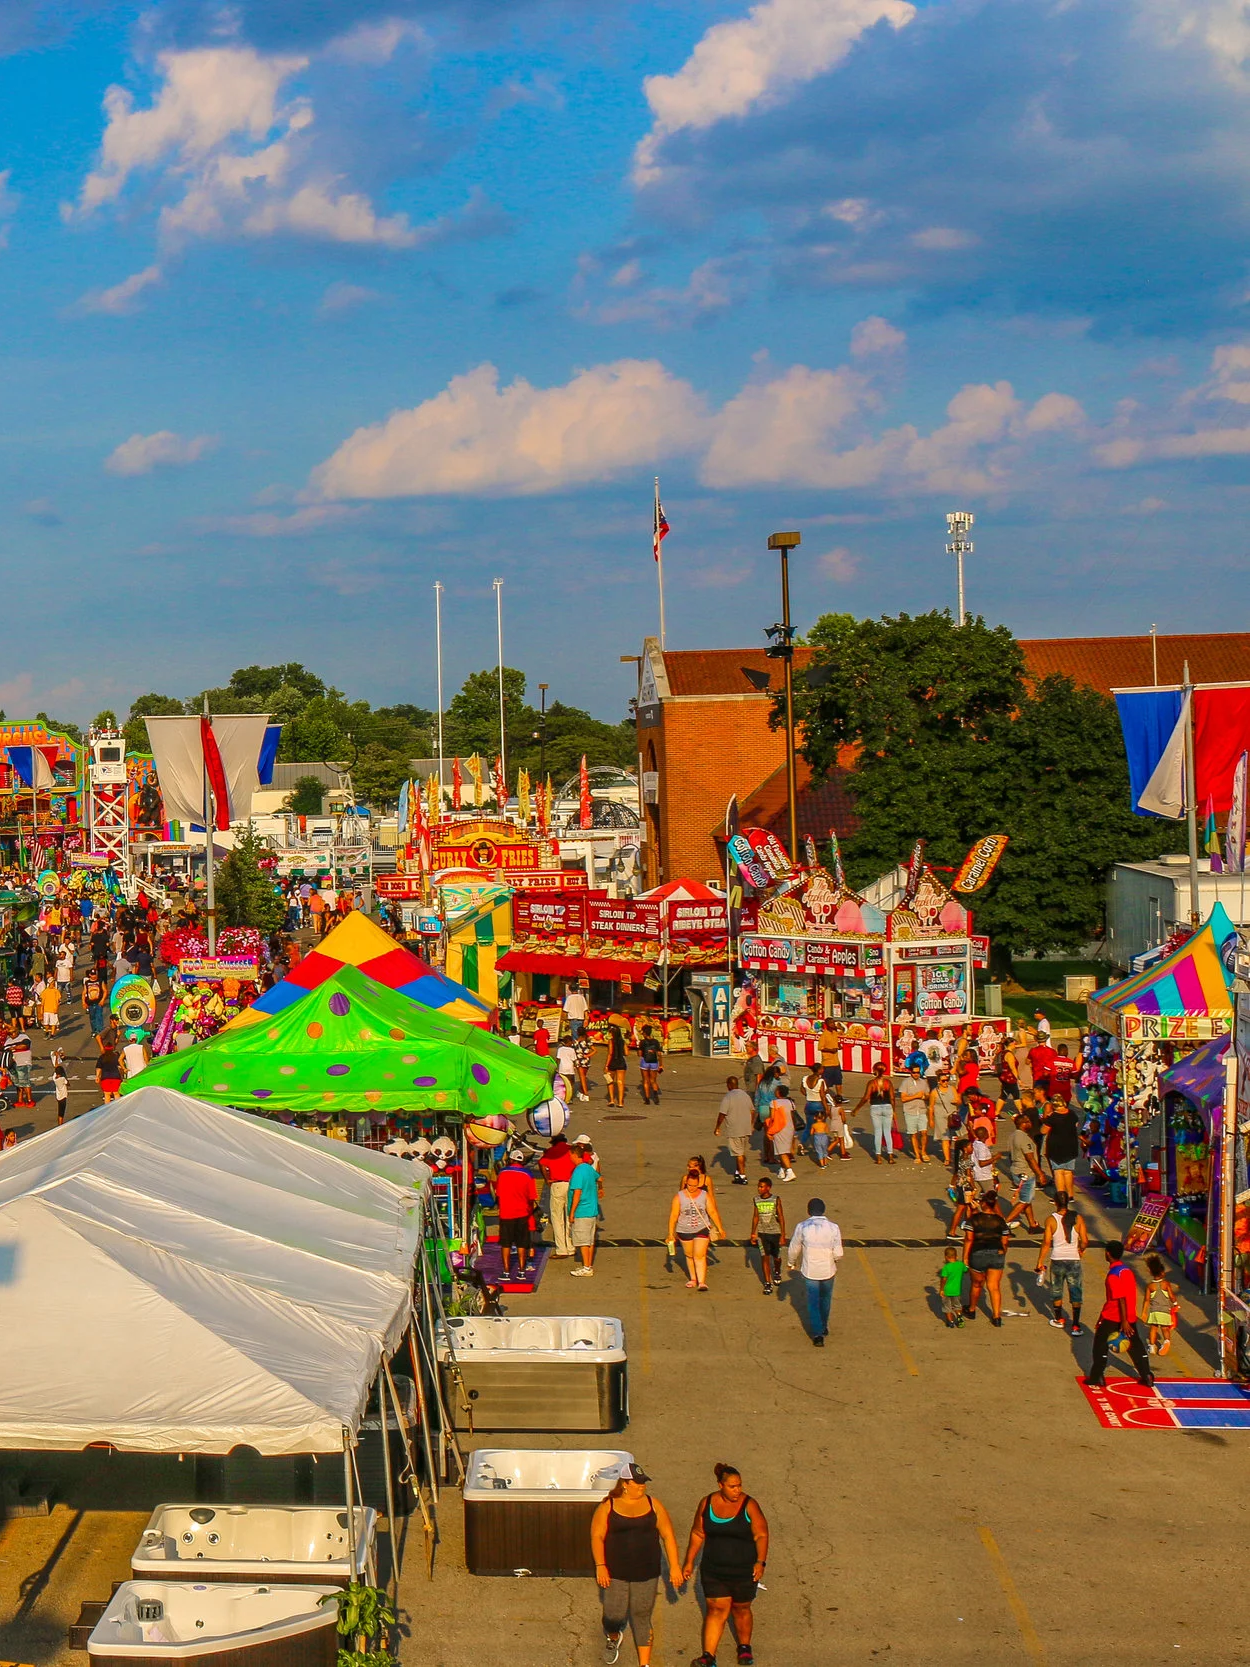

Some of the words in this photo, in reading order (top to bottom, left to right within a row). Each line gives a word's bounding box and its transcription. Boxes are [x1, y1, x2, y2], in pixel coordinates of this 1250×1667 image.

[766, 835, 775, 846] Old
[432, 851, 467, 871] CURLY
[501, 850, 534, 867] FRIES
[734, 837, 754, 866] Cotton
[749, 862, 768, 888] Candy
[961, 855, 987, 890] Caramel
[978, 837, 998, 858] Corn
[390, 880, 406, 891] DOGS
[506, 878, 524, 887] RLY
[527, 877, 557, 886] FRIES
[530, 903, 554, 915] SIRLOIN
[599, 909, 624, 919] SIRLOIN
[626, 910, 636, 920] TIP
[676, 906, 708, 918] SIRLOIN
[709, 905, 724, 917] TIP
[591, 920, 614, 931] STEAK
[615, 921, 645, 933] DINNERS
[672, 919, 702, 931] RIBEYE
[703, 917, 728, 930] STEA
[806, 944, 824, 954] Candy
[825, 945, 831, 954] &
[972, 940, 984, 948] Cold
[743, 942, 767, 958] Cotton
[768, 943, 791, 960] Candy
[806, 954, 830, 964] Caramel
[831, 948, 857, 965] Apples
[868, 948, 879, 957] Sno
[866, 956, 882, 966] Cones
[932, 970, 948, 978] ICE
[929, 982, 952, 990] DRINKS
[920, 997, 942, 1010] Cotton
[943, 995, 964, 1010] Candy
[713, 987, 729, 1038] ATM
[1125, 1016, 1199, 1039] PRIZE
[1139, 1201, 1166, 1219] FREE
[1135, 1215, 1159, 1227] BEAR
